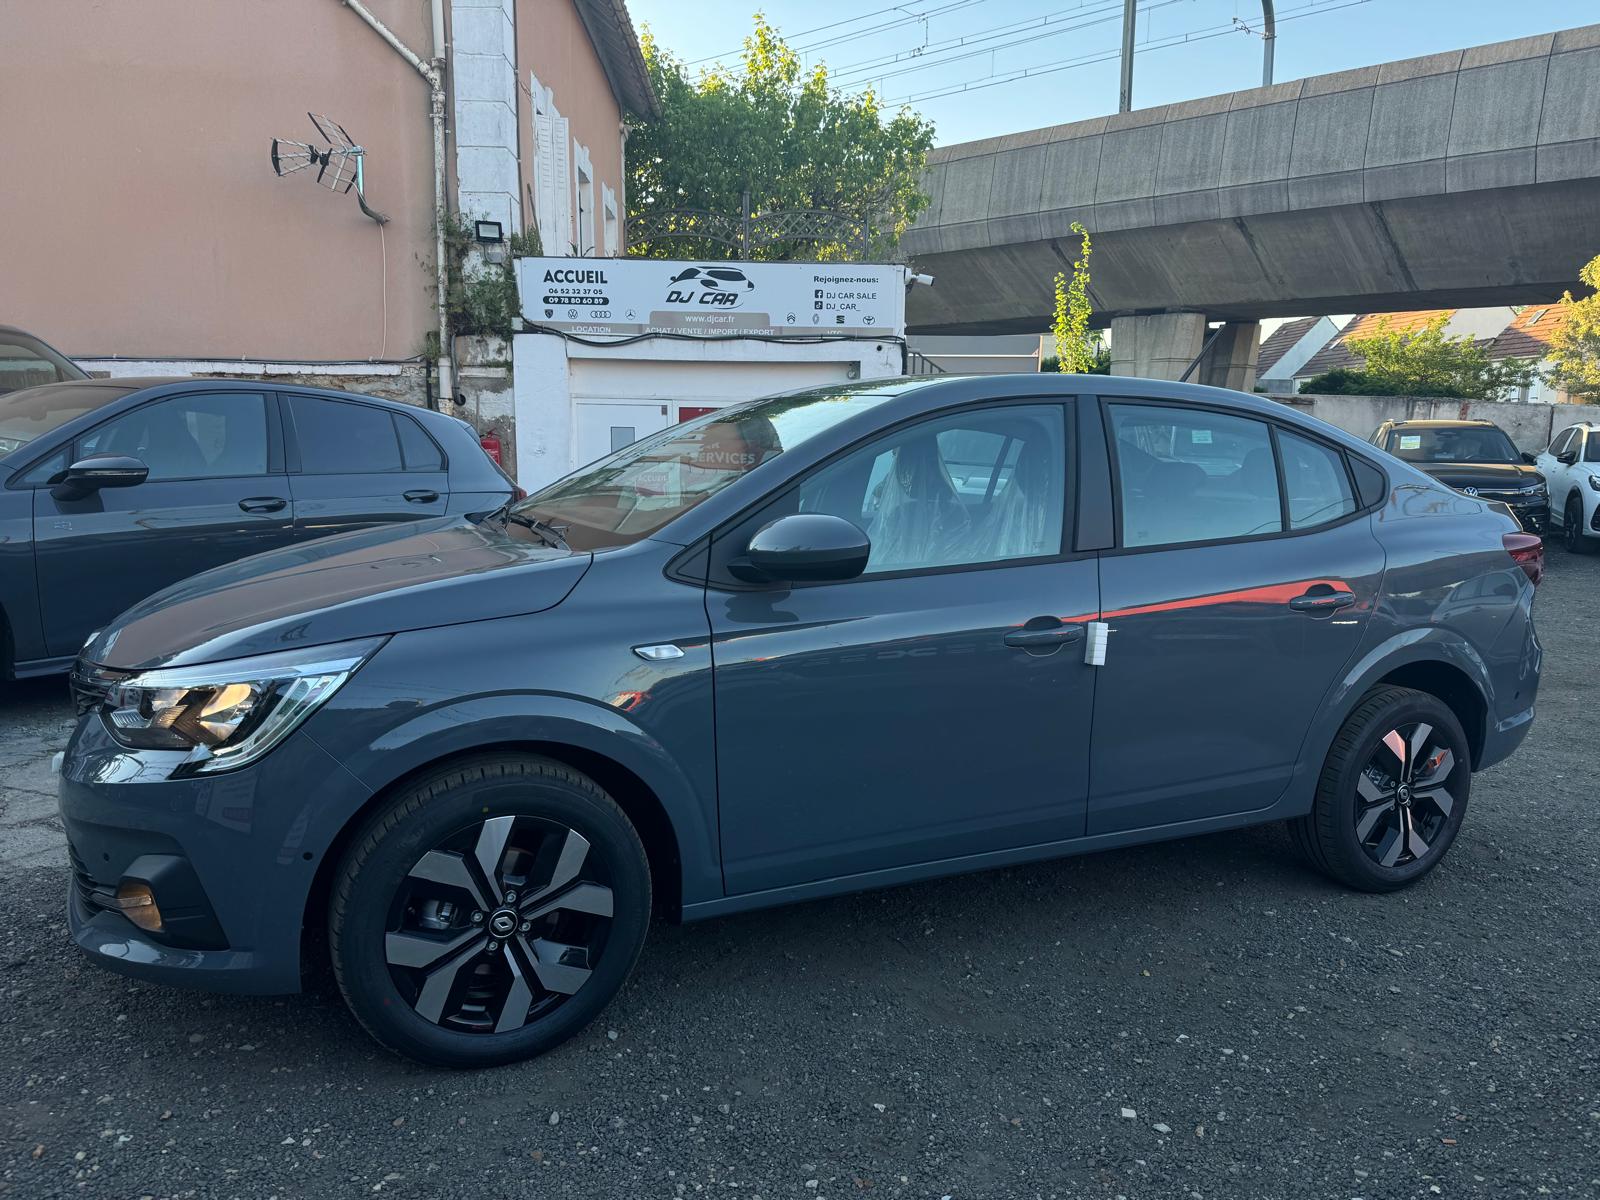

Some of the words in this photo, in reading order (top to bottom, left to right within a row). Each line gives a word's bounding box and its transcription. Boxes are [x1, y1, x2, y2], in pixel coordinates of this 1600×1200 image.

[543, 269, 608, 284] ACCUEIL
[813, 275, 879, 284] Rejoignez-nous:
[665, 291, 695, 303] DJ
[699, 292, 739, 306] CAR
[685, 314, 735, 324] www.djcar.fr
[691, 451, 755, 464] SERVICES
